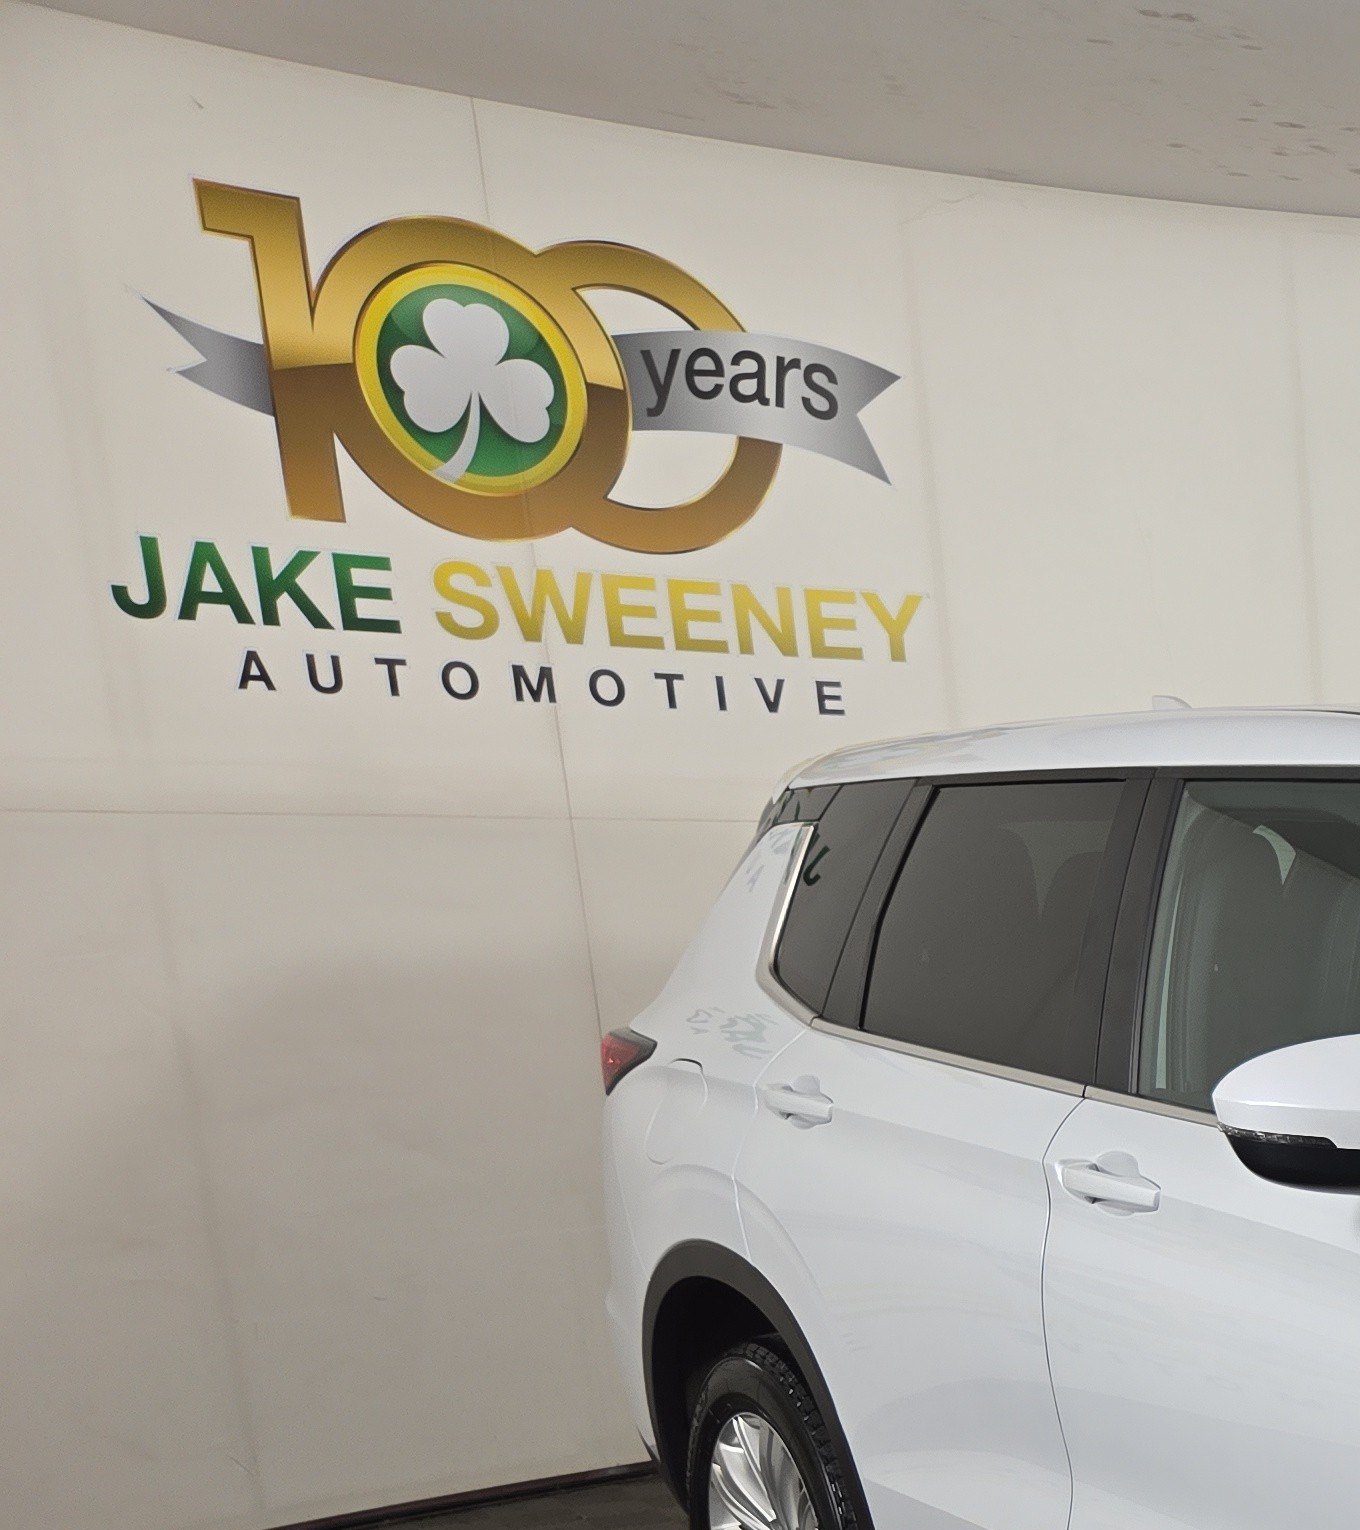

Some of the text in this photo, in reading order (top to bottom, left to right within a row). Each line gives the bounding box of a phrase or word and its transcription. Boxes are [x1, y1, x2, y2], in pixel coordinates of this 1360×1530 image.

[640, 346, 840, 422] years
[110, 534, 924, 664] JAKE SWEENEY
[237, 649, 847, 717] AUTOMOTIVE
